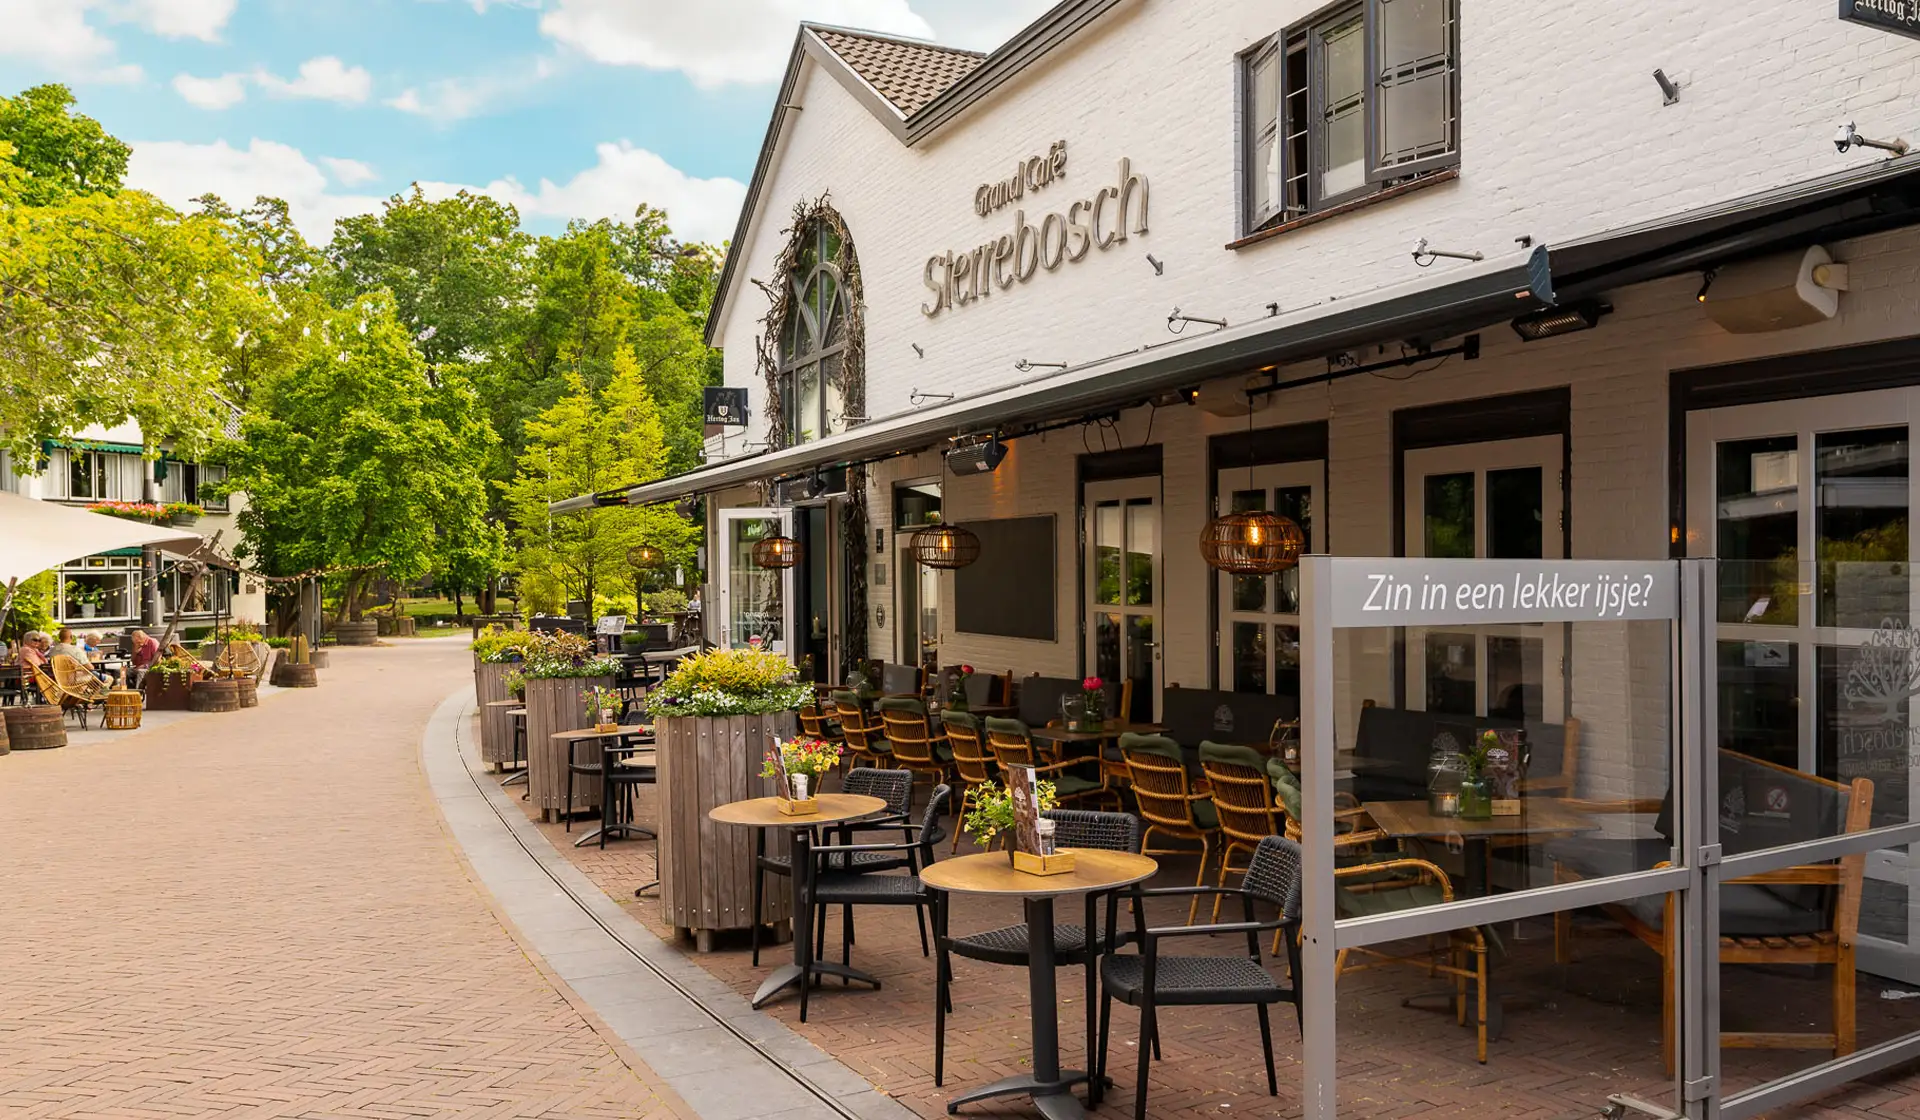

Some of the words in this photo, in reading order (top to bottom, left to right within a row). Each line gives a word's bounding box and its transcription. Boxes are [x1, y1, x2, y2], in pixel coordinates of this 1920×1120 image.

[974, 161, 1026, 217] Grand
[1025, 139, 1068, 191] Café
[921, 156, 1150, 319] Sterrebosch
[1362, 574, 1412, 611] Zin
[1420, 575, 1448, 610] in
[1455, 582, 1505, 610] een
[1512, 572, 1591, 609] lekker
[1595, 574, 1654, 617] ijsje?
